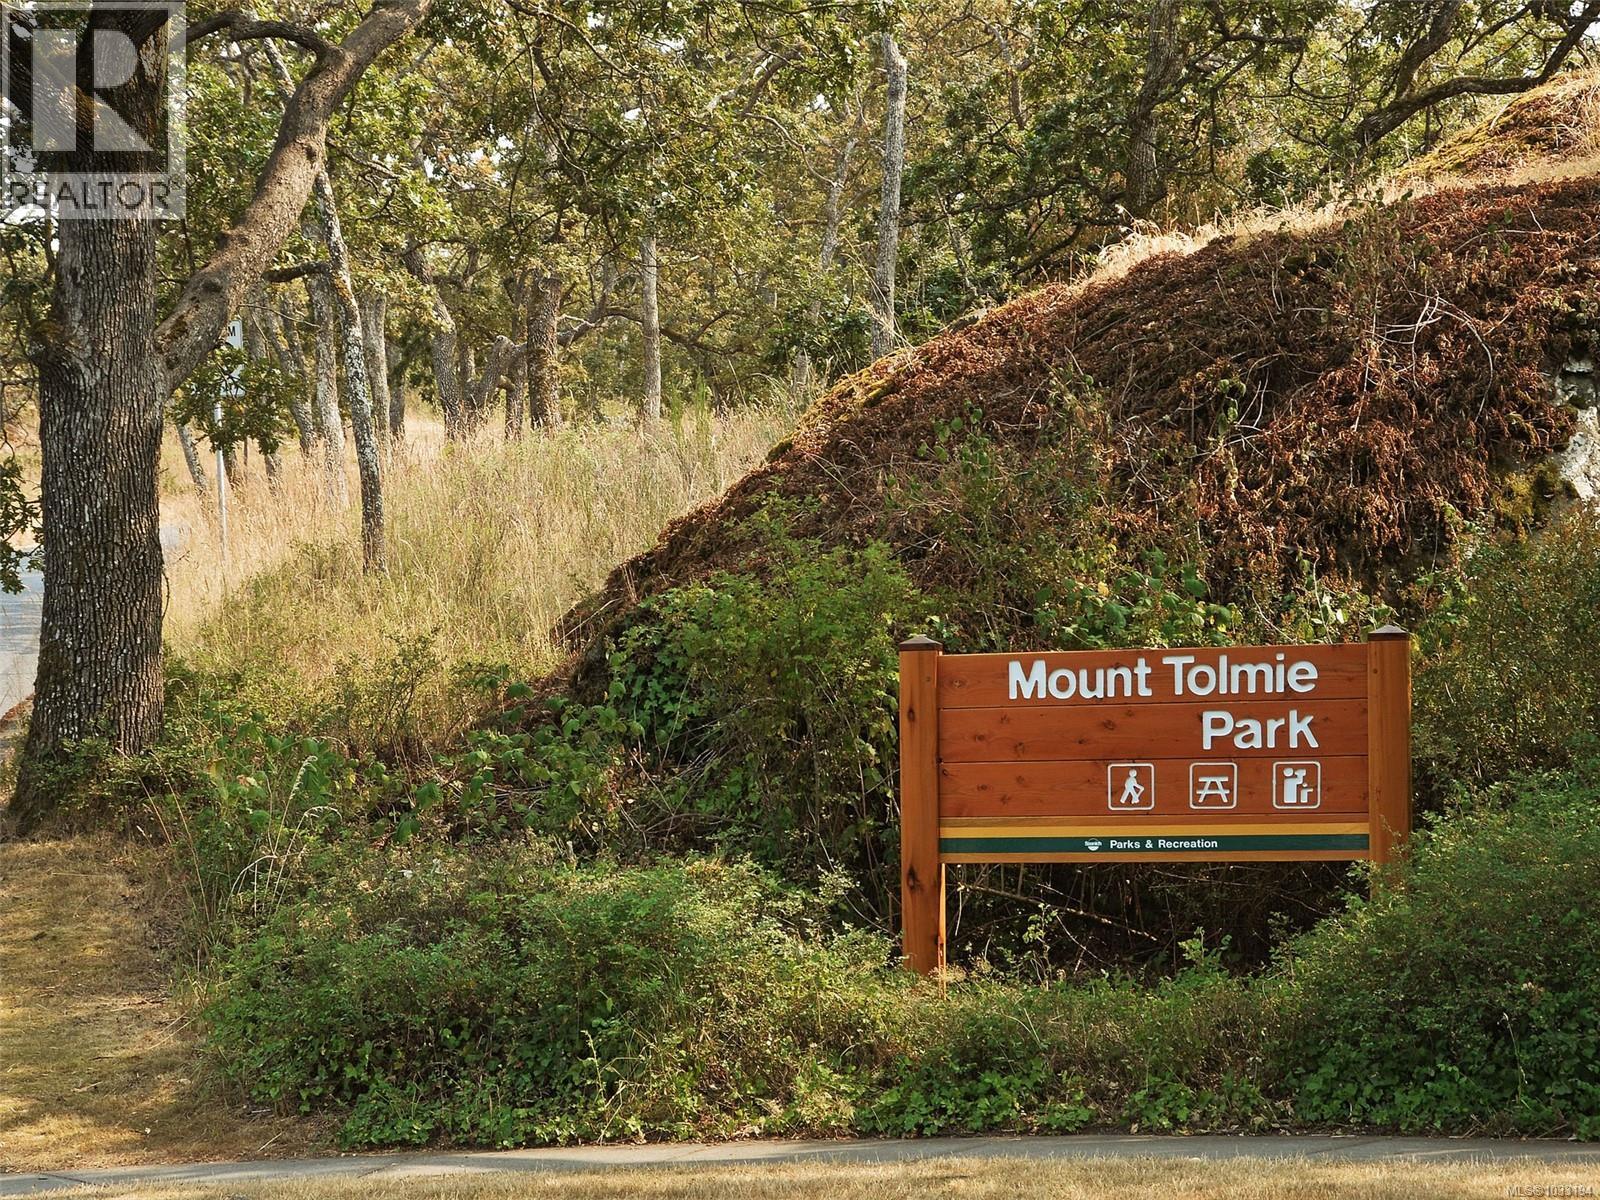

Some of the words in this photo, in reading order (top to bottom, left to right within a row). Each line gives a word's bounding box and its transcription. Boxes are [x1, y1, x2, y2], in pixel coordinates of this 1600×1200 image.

[1008, 657, 1153, 699] Mount
[1162, 653, 1318, 696] Tolmie
[1202, 709, 1319, 750] Park
[1110, 839, 1141, 849] Parks
[1145, 839, 1153, 849] &
[1158, 838, 1218, 849] Recreation
